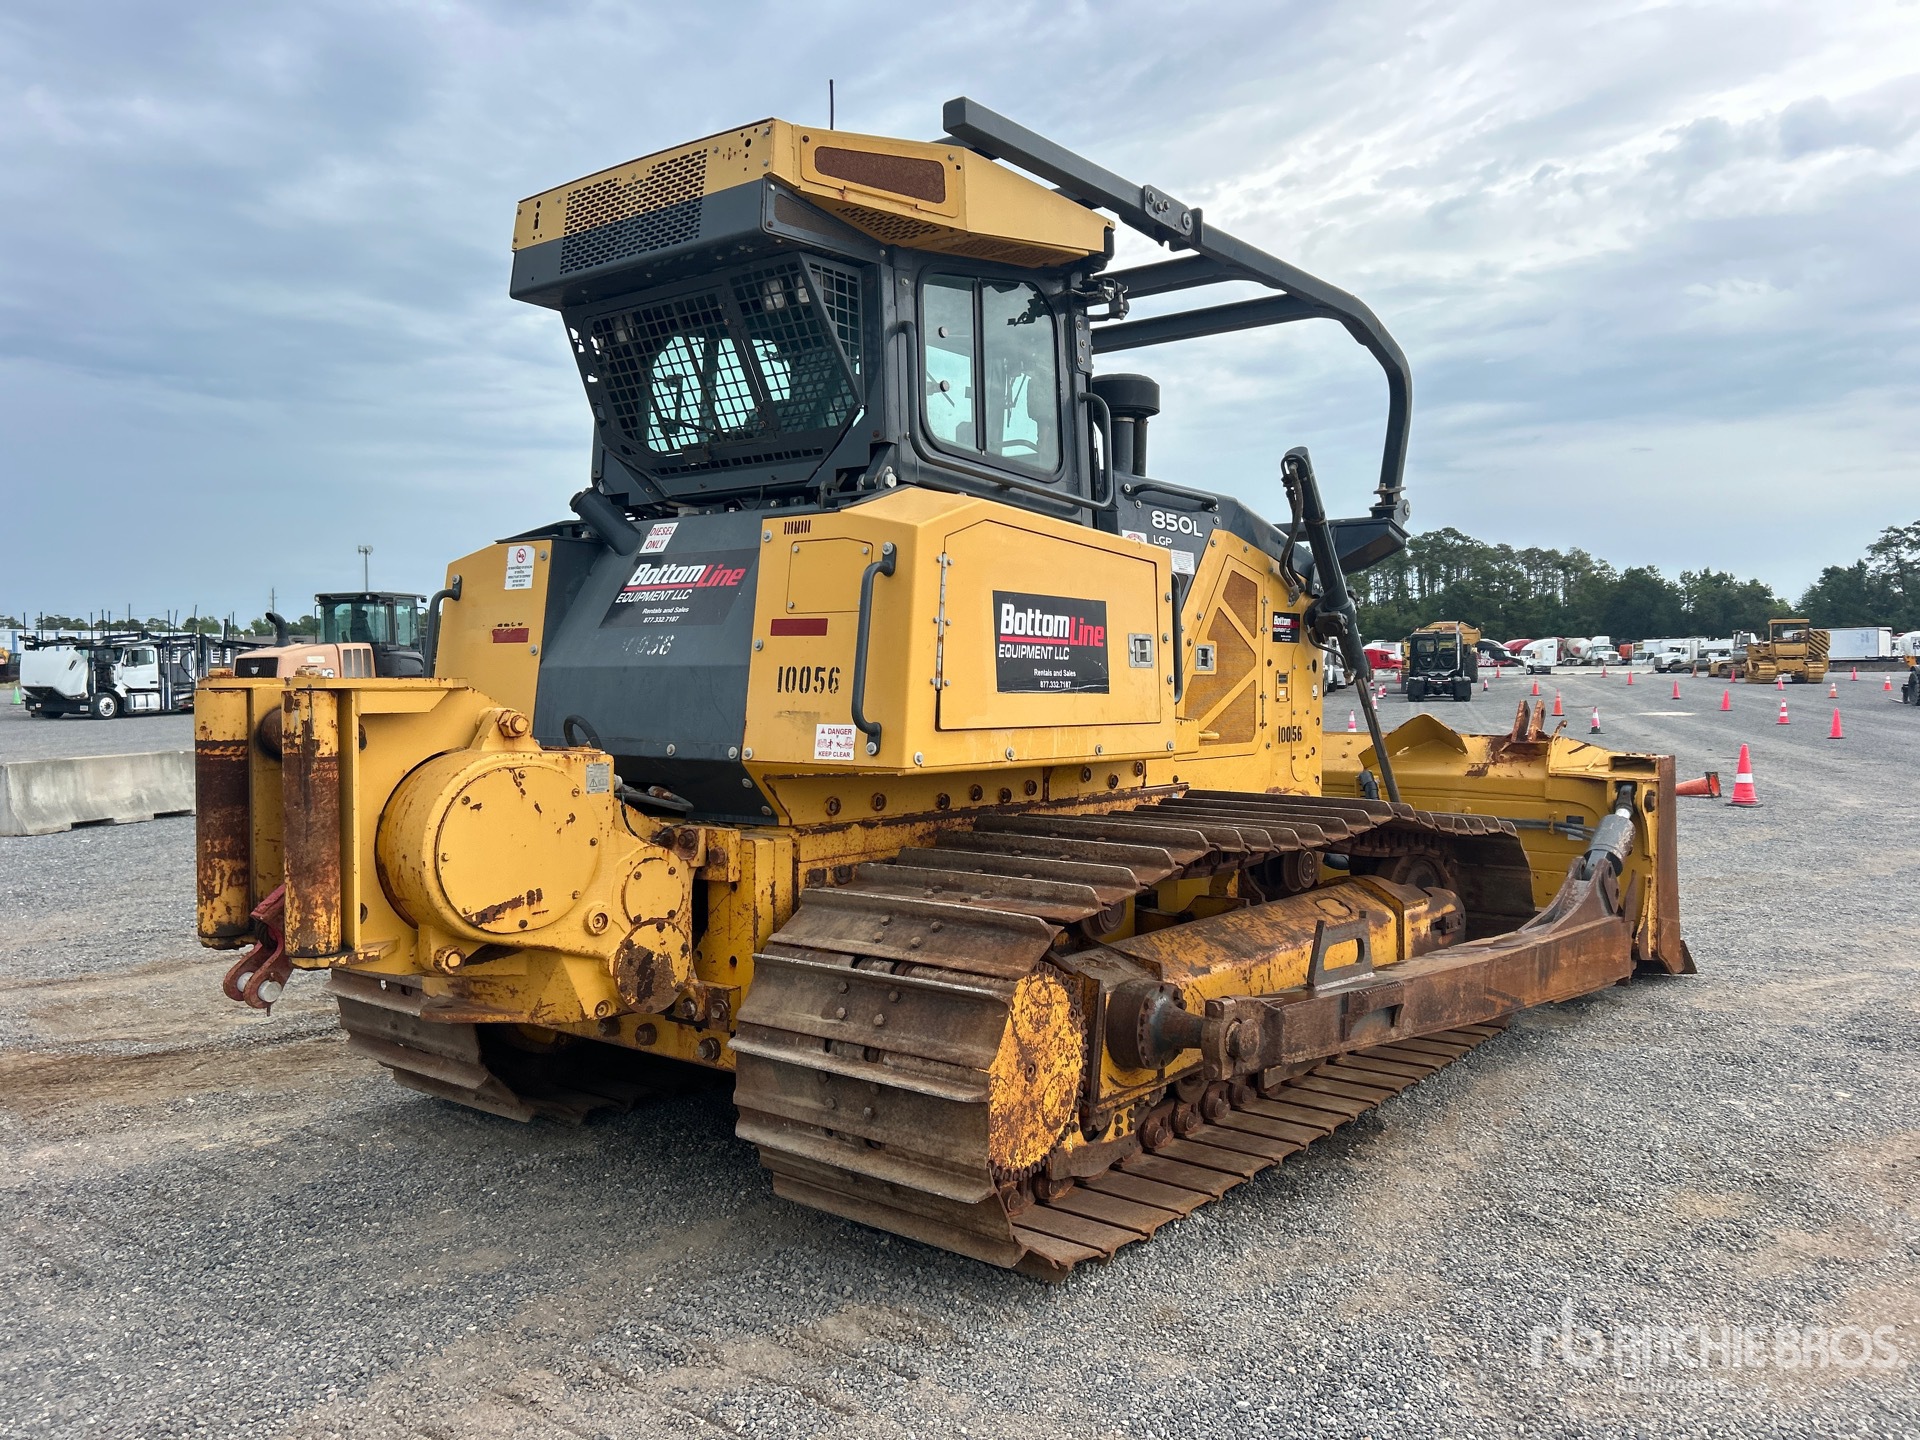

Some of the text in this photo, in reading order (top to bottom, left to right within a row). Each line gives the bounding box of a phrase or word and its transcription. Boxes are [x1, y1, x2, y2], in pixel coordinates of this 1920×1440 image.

[649, 526, 674, 536] DIESEL
[1151, 510, 1204, 538] 850L
[645, 540, 665, 549] ONLY
[1153, 535, 1173, 546] LGP
[615, 589, 693, 603] EQUIPMENT LLC
[998, 643, 1070, 660] EQUIPMENT LLC
[777, 666, 841, 694] 10056
[1034, 669, 1053, 677] Rentals
[1063, 669, 1076, 677] Sales
[1278, 726, 1302, 744] 10056
